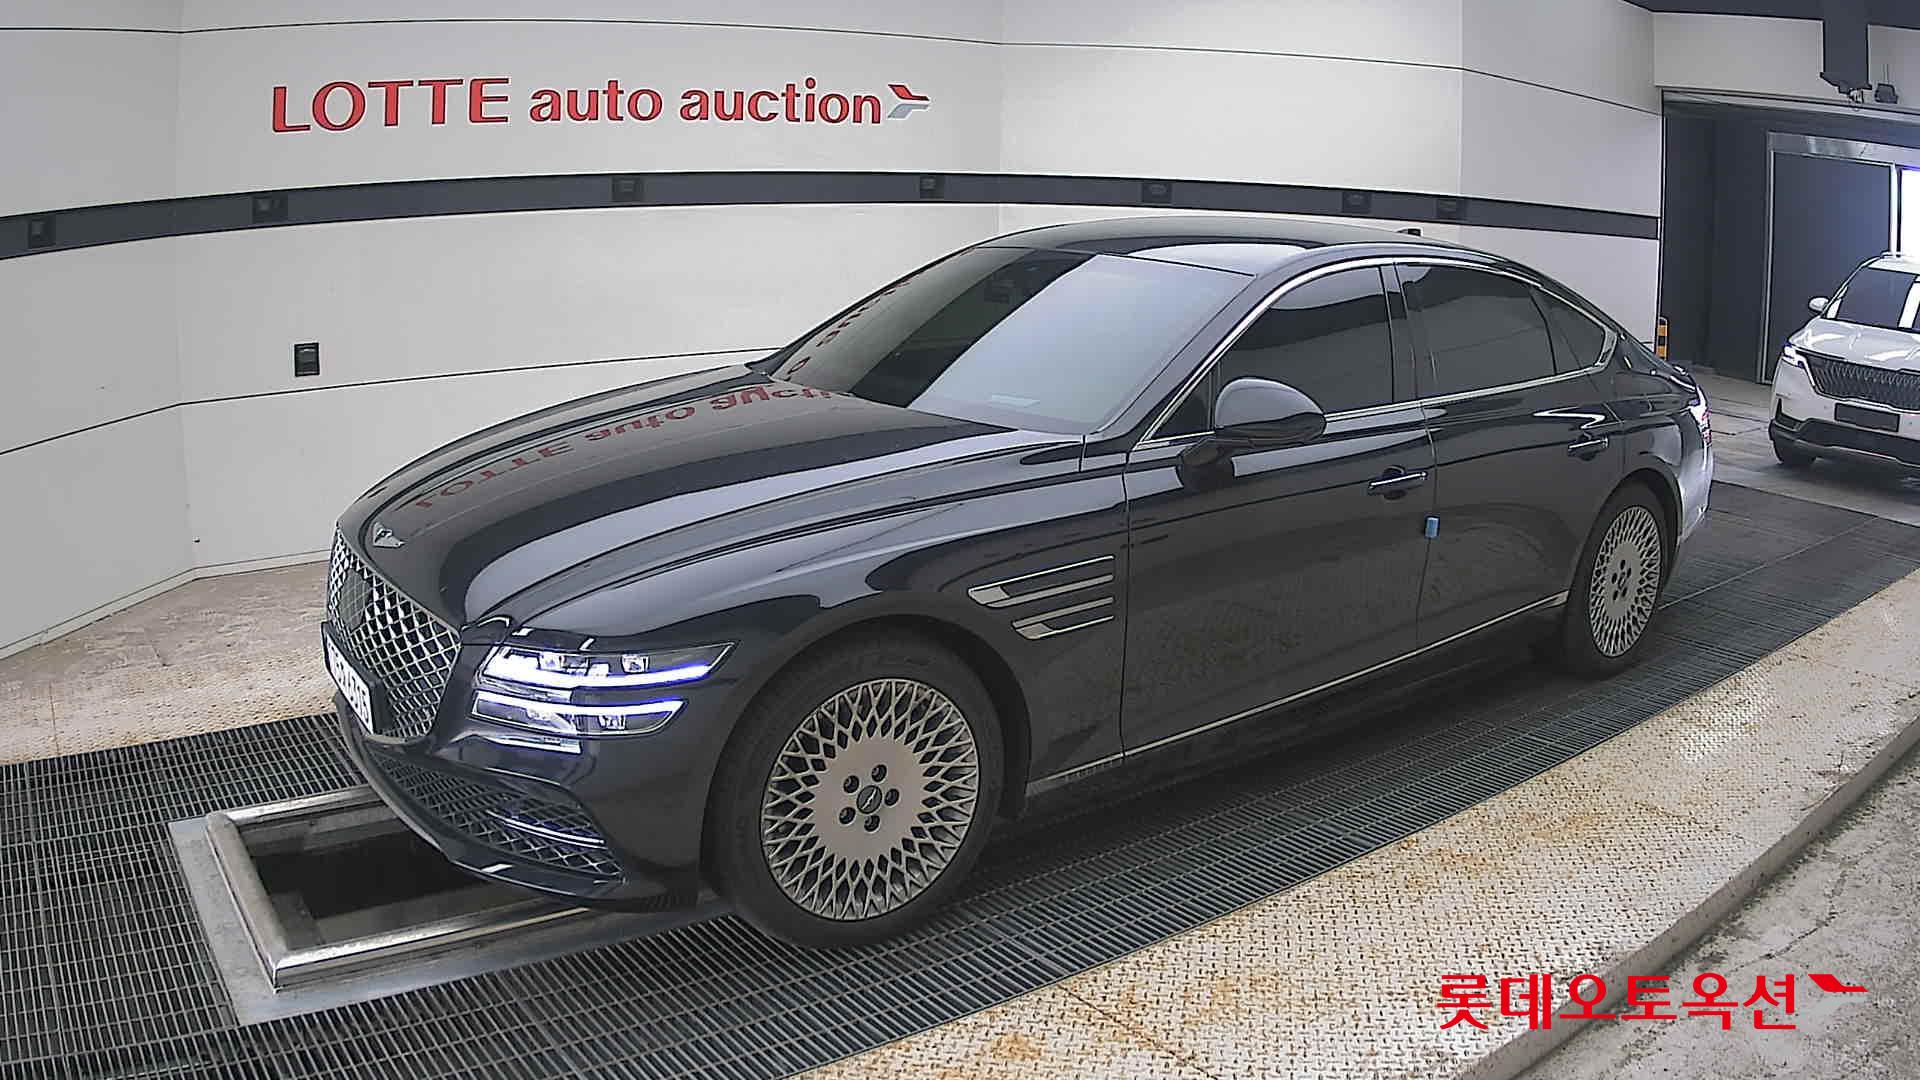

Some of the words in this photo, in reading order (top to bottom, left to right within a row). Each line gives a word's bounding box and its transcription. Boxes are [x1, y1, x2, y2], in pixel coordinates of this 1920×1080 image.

[271, 78, 509, 134] LOTTE
[530, 79, 663, 123] auto
[680, 77, 882, 125] auction
